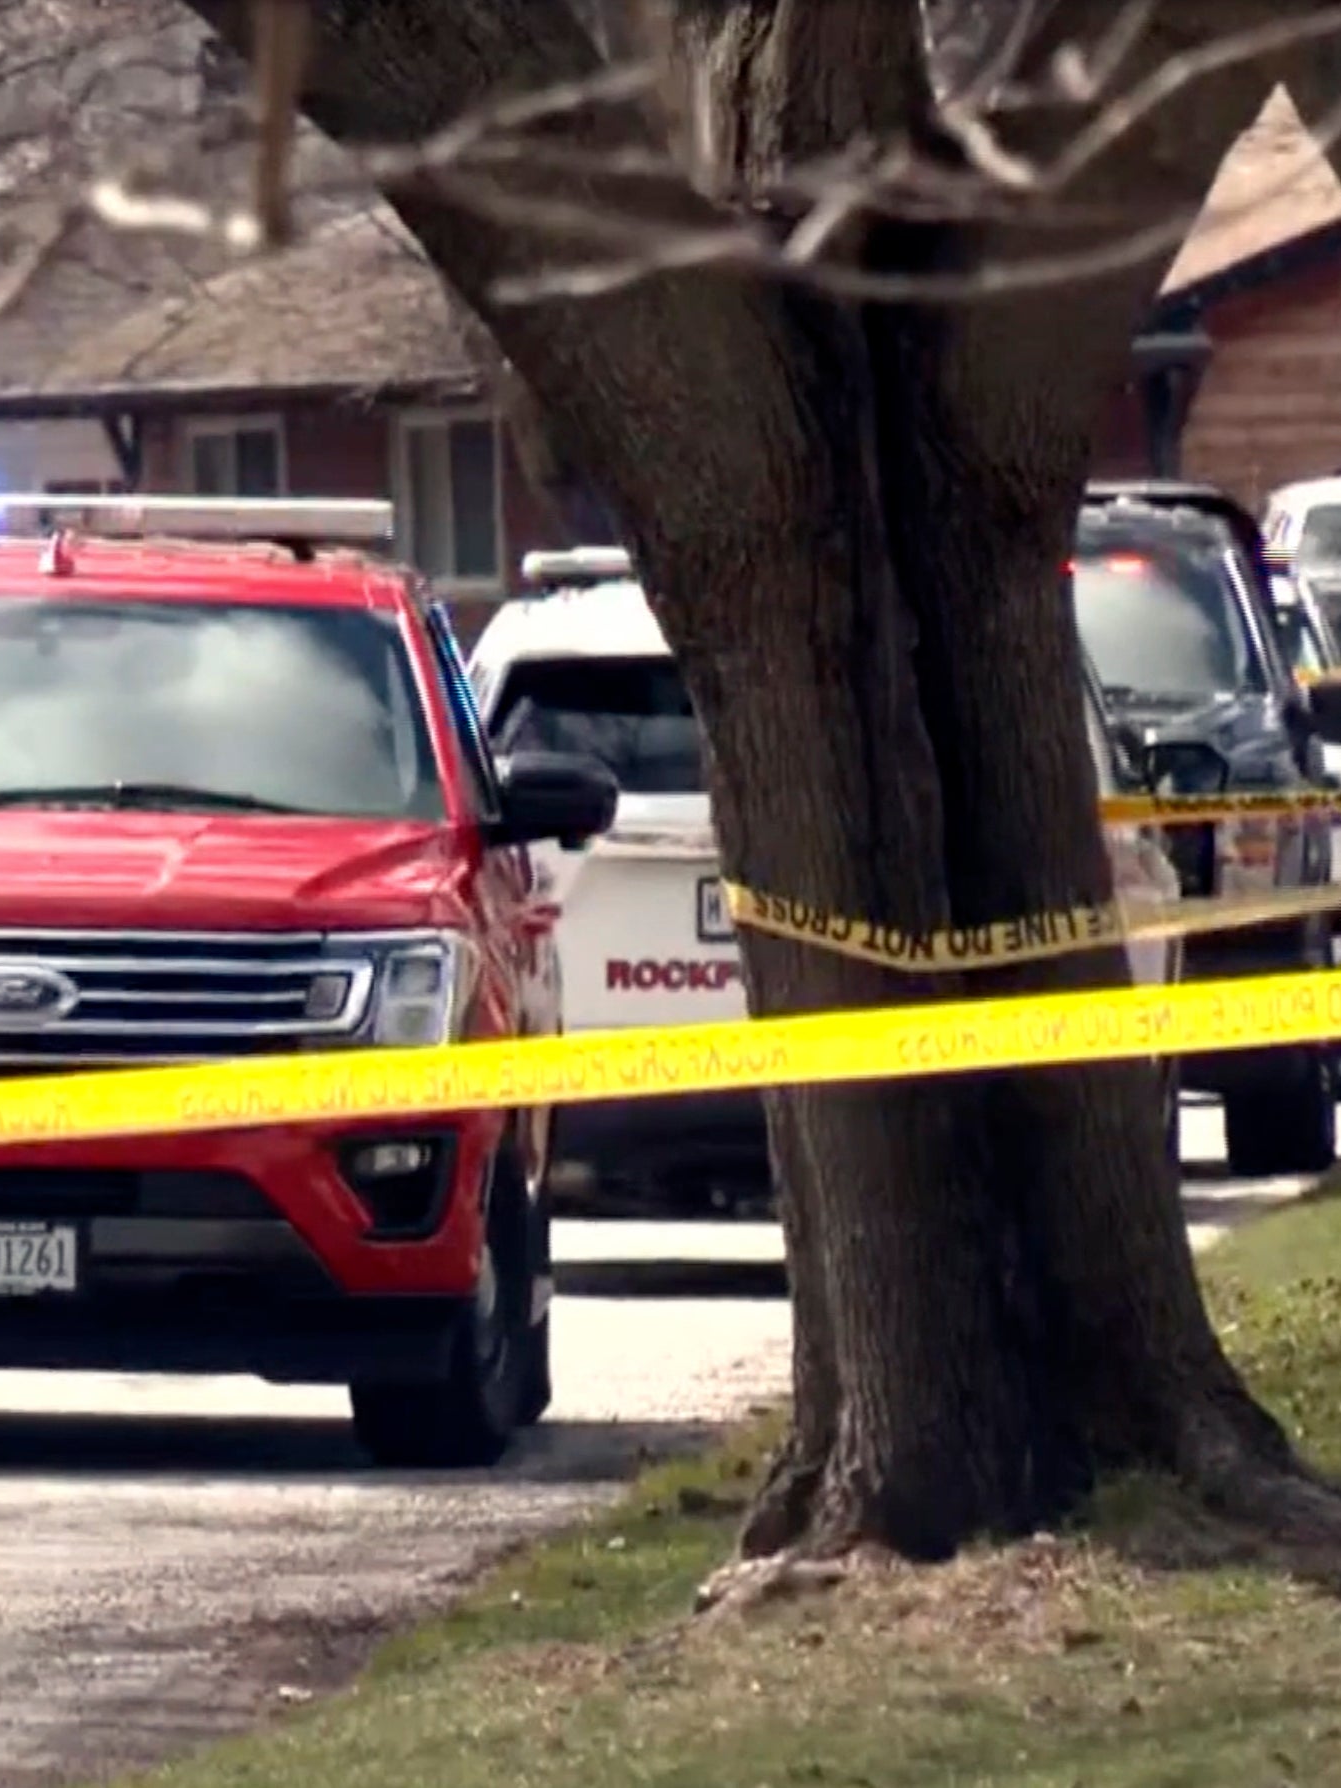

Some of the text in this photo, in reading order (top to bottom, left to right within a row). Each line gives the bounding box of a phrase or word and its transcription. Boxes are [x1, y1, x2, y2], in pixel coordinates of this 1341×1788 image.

[753, 896, 853, 942] CROSS
[860, 919, 937, 962] NOT
[947, 924, 993, 958] DO
[1004, 903, 1079, 952] LINE
